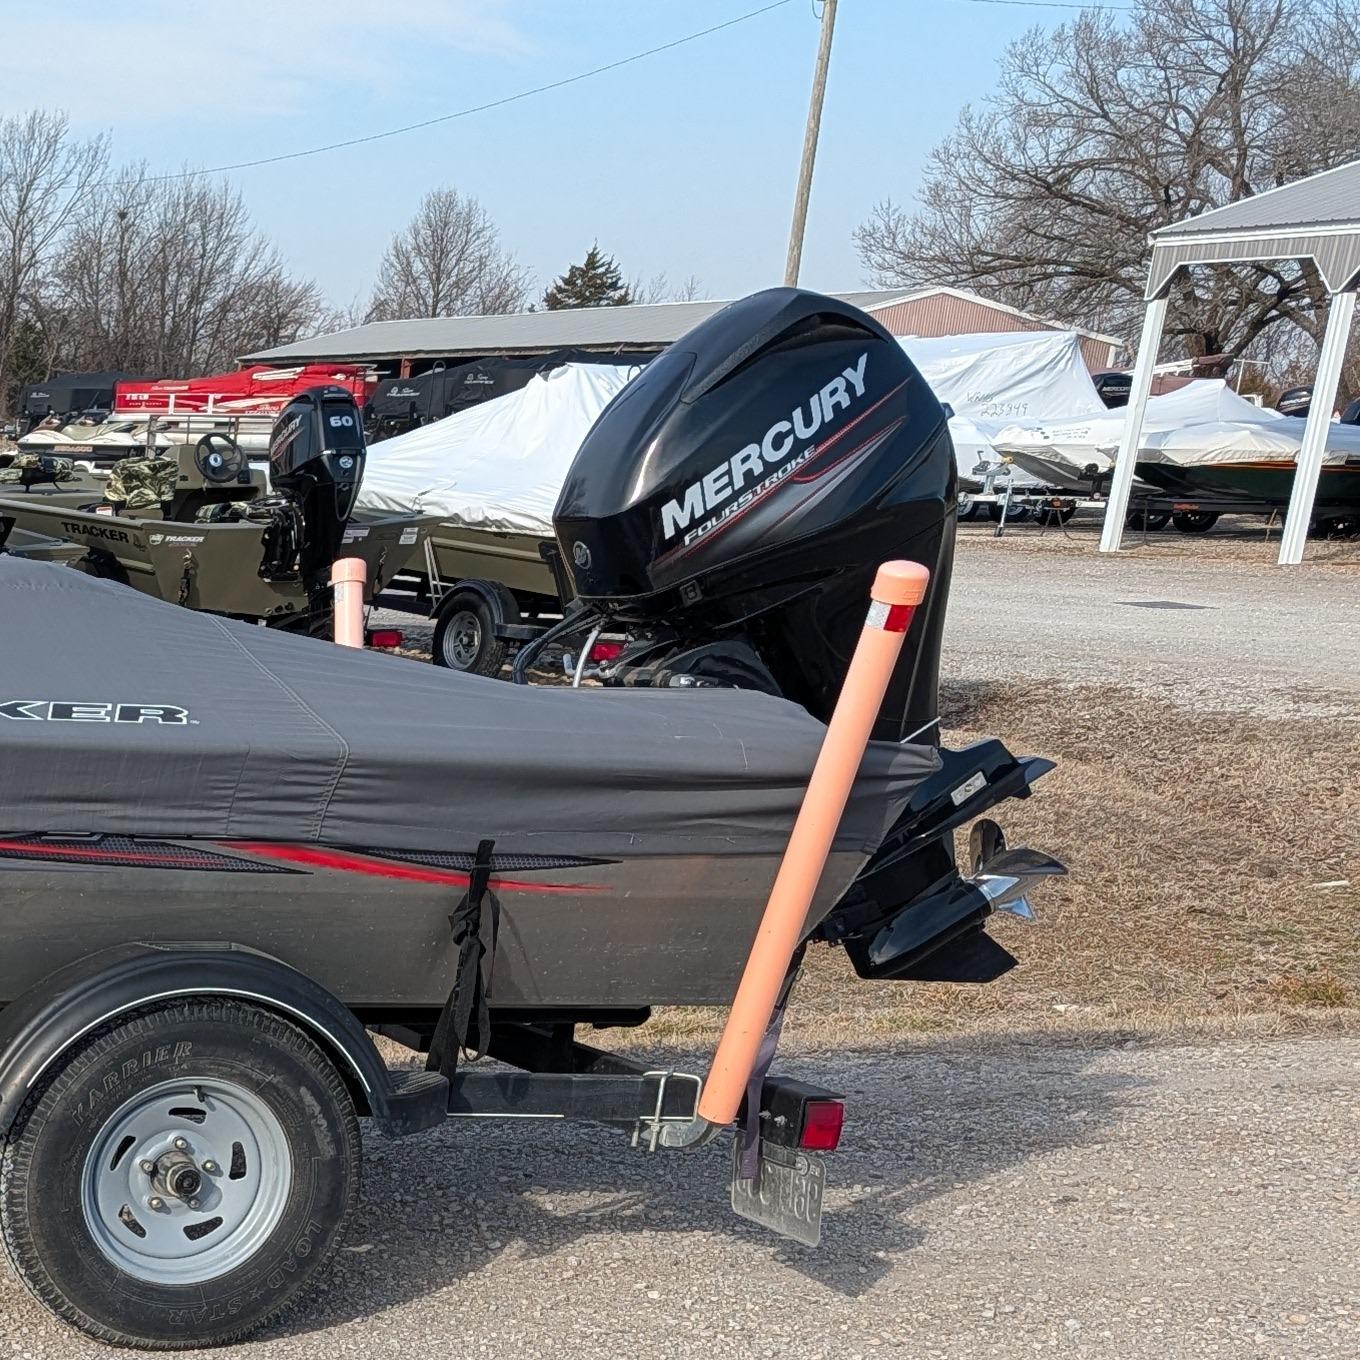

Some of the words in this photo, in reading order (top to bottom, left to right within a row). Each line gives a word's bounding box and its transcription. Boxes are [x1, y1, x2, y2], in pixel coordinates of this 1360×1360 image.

[329, 415, 354, 428] 60
[661, 352, 868, 540] MERCURY
[683, 444, 817, 547] FOURSTROKE
[61, 522, 130, 544] TRACKER
[165, 535, 206, 543] TRACKER
[266, 1219, 323, 1290] LOAD
[167, 1296, 244, 1326] STAR
